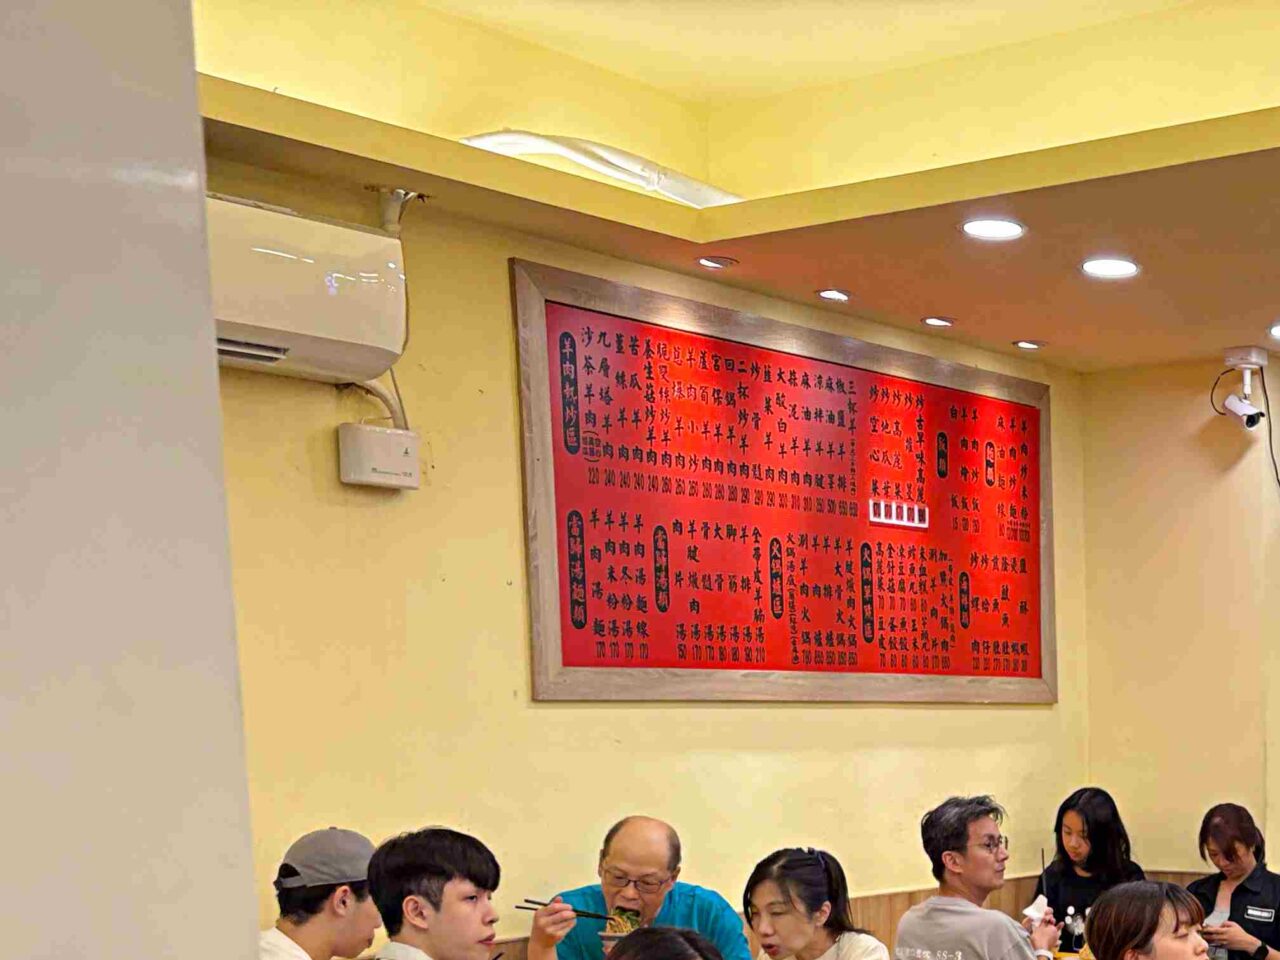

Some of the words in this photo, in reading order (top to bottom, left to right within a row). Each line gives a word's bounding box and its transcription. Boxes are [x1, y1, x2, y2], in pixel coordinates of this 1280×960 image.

[581, 326, 597, 428] 沙茶羊肉
[686, 348, 699, 473] 羊肉小炒
